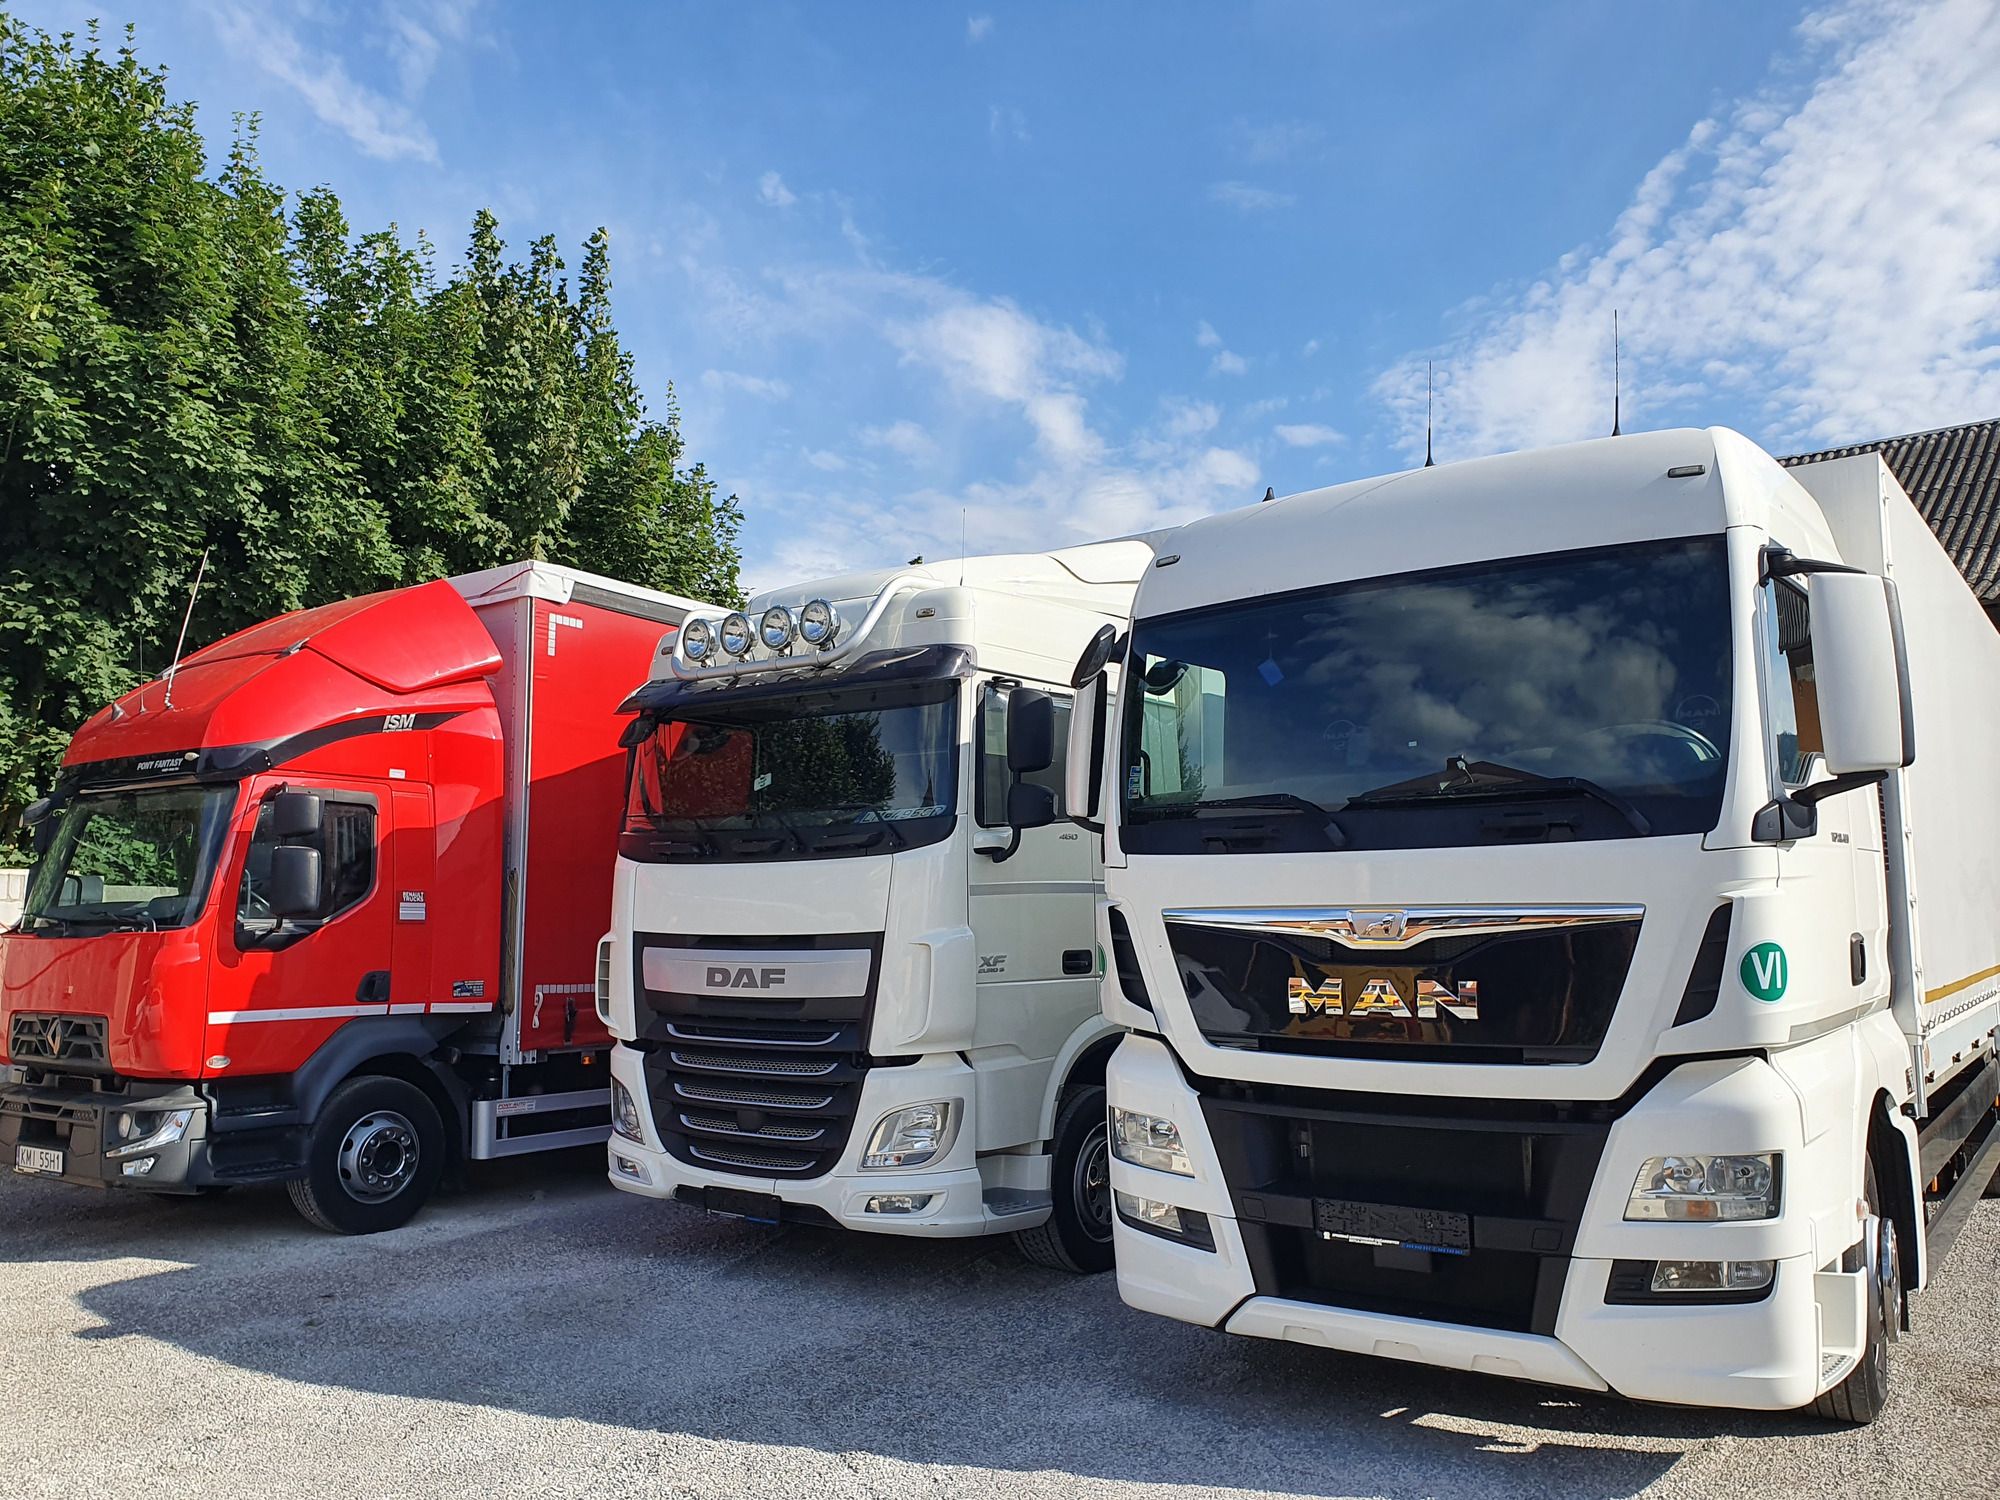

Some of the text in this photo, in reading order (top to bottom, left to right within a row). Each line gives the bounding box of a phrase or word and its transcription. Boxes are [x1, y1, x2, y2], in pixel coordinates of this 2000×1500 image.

[383, 713, 416, 729] ISM
[136, 761, 153, 771] PONY
[154, 758, 184, 768] FANTASY
[979, 955, 1007, 967] XF
[1750, 951, 1782, 990] VI
[706, 967, 786, 988] DAF
[1288, 977, 1479, 1019] MAN
[21, 1148, 60, 1170] KMI 55H1
